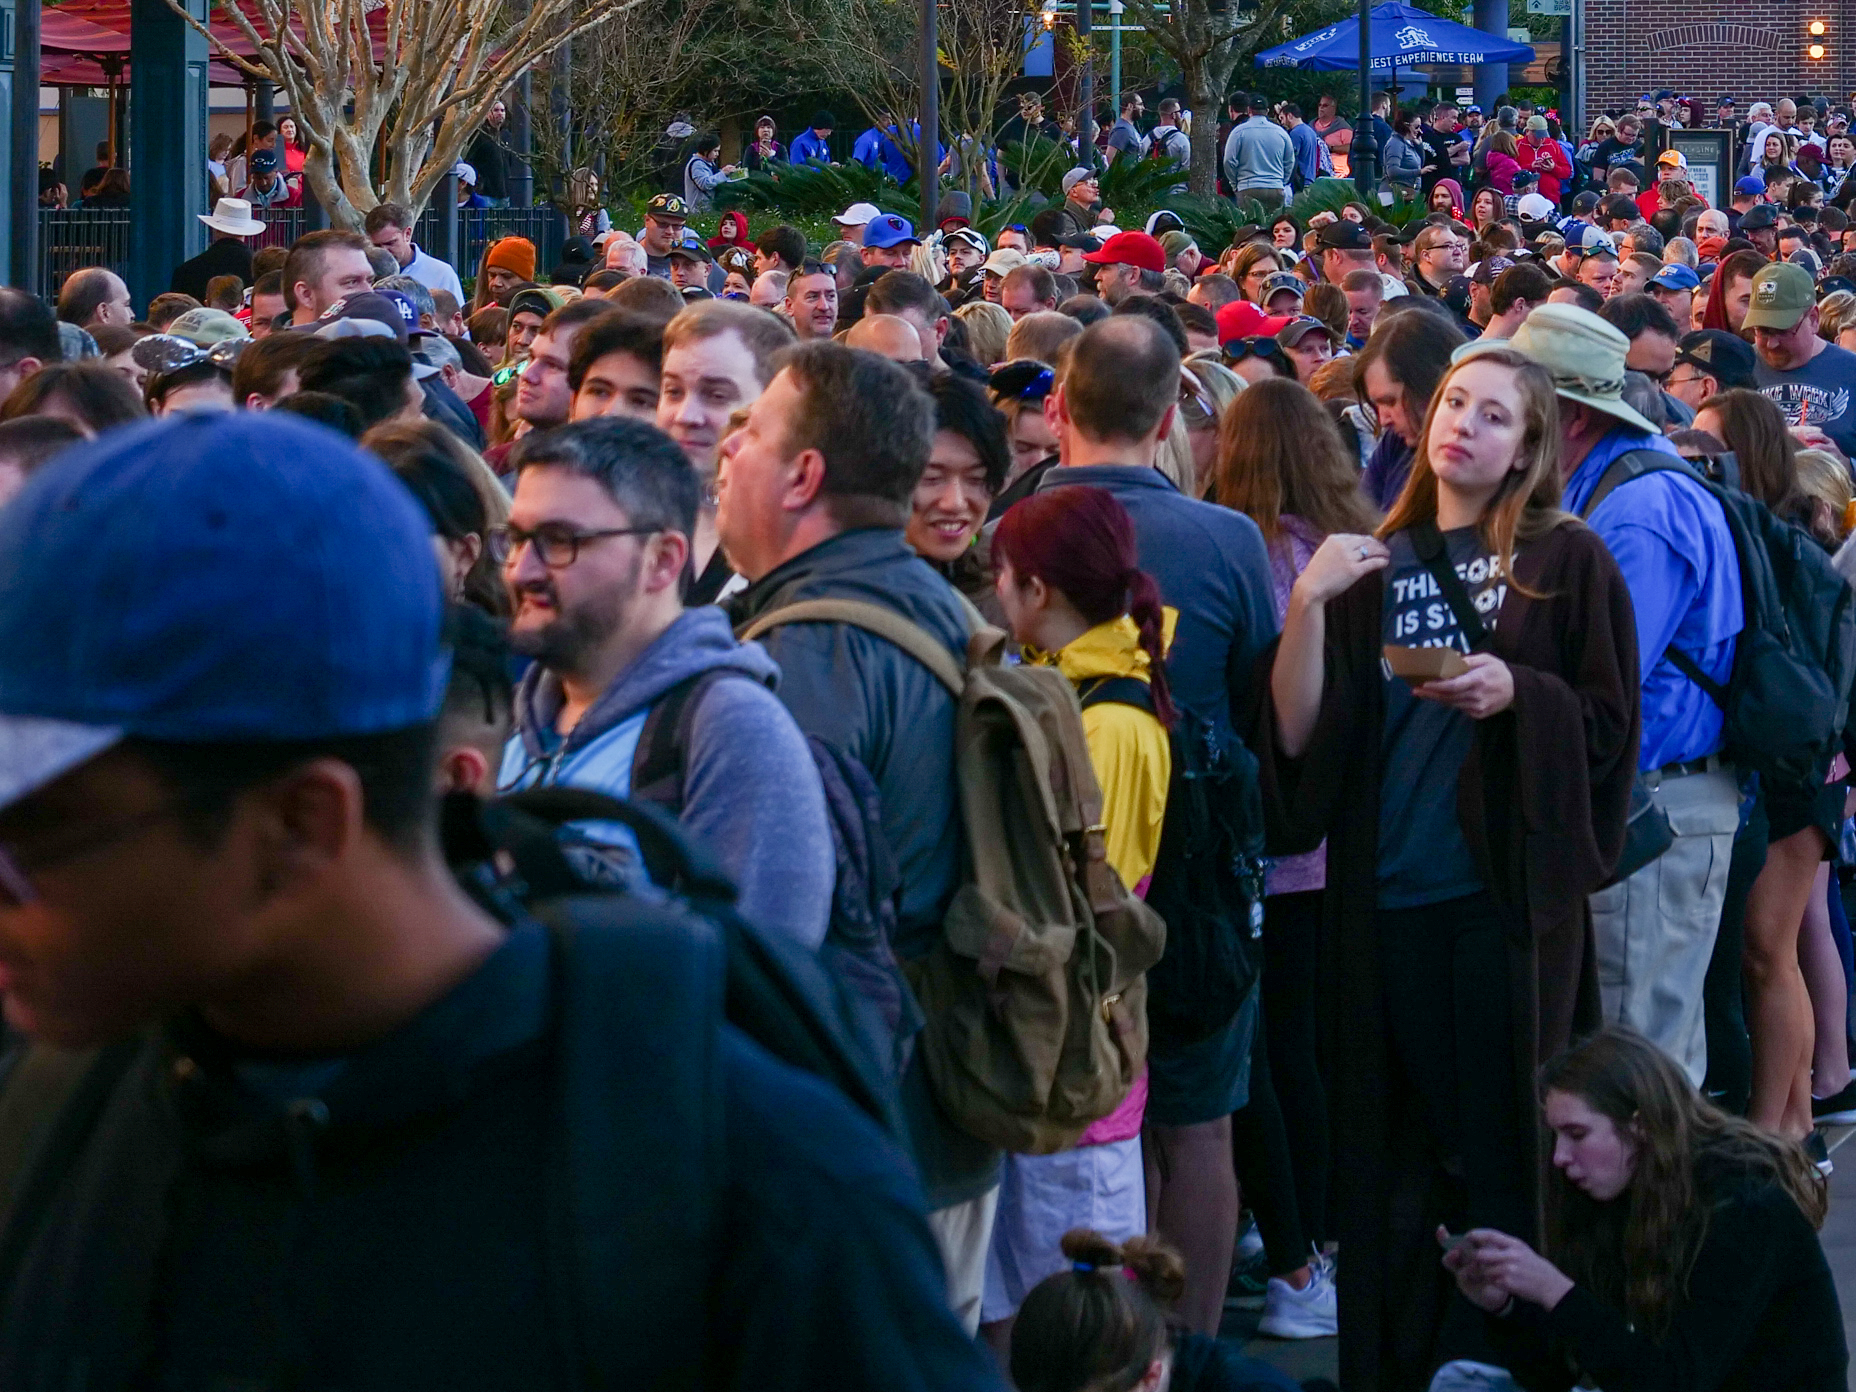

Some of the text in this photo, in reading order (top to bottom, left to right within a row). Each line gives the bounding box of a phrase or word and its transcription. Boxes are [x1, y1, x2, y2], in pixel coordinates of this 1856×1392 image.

[1395, 52, 1455, 65] EXPERIENCE
[1457, 52, 1484, 63] TEAM
[396, 298, 413, 320] LA
[1789, 384, 1828, 408] WEEK
[1396, 610, 1420, 639] IS
